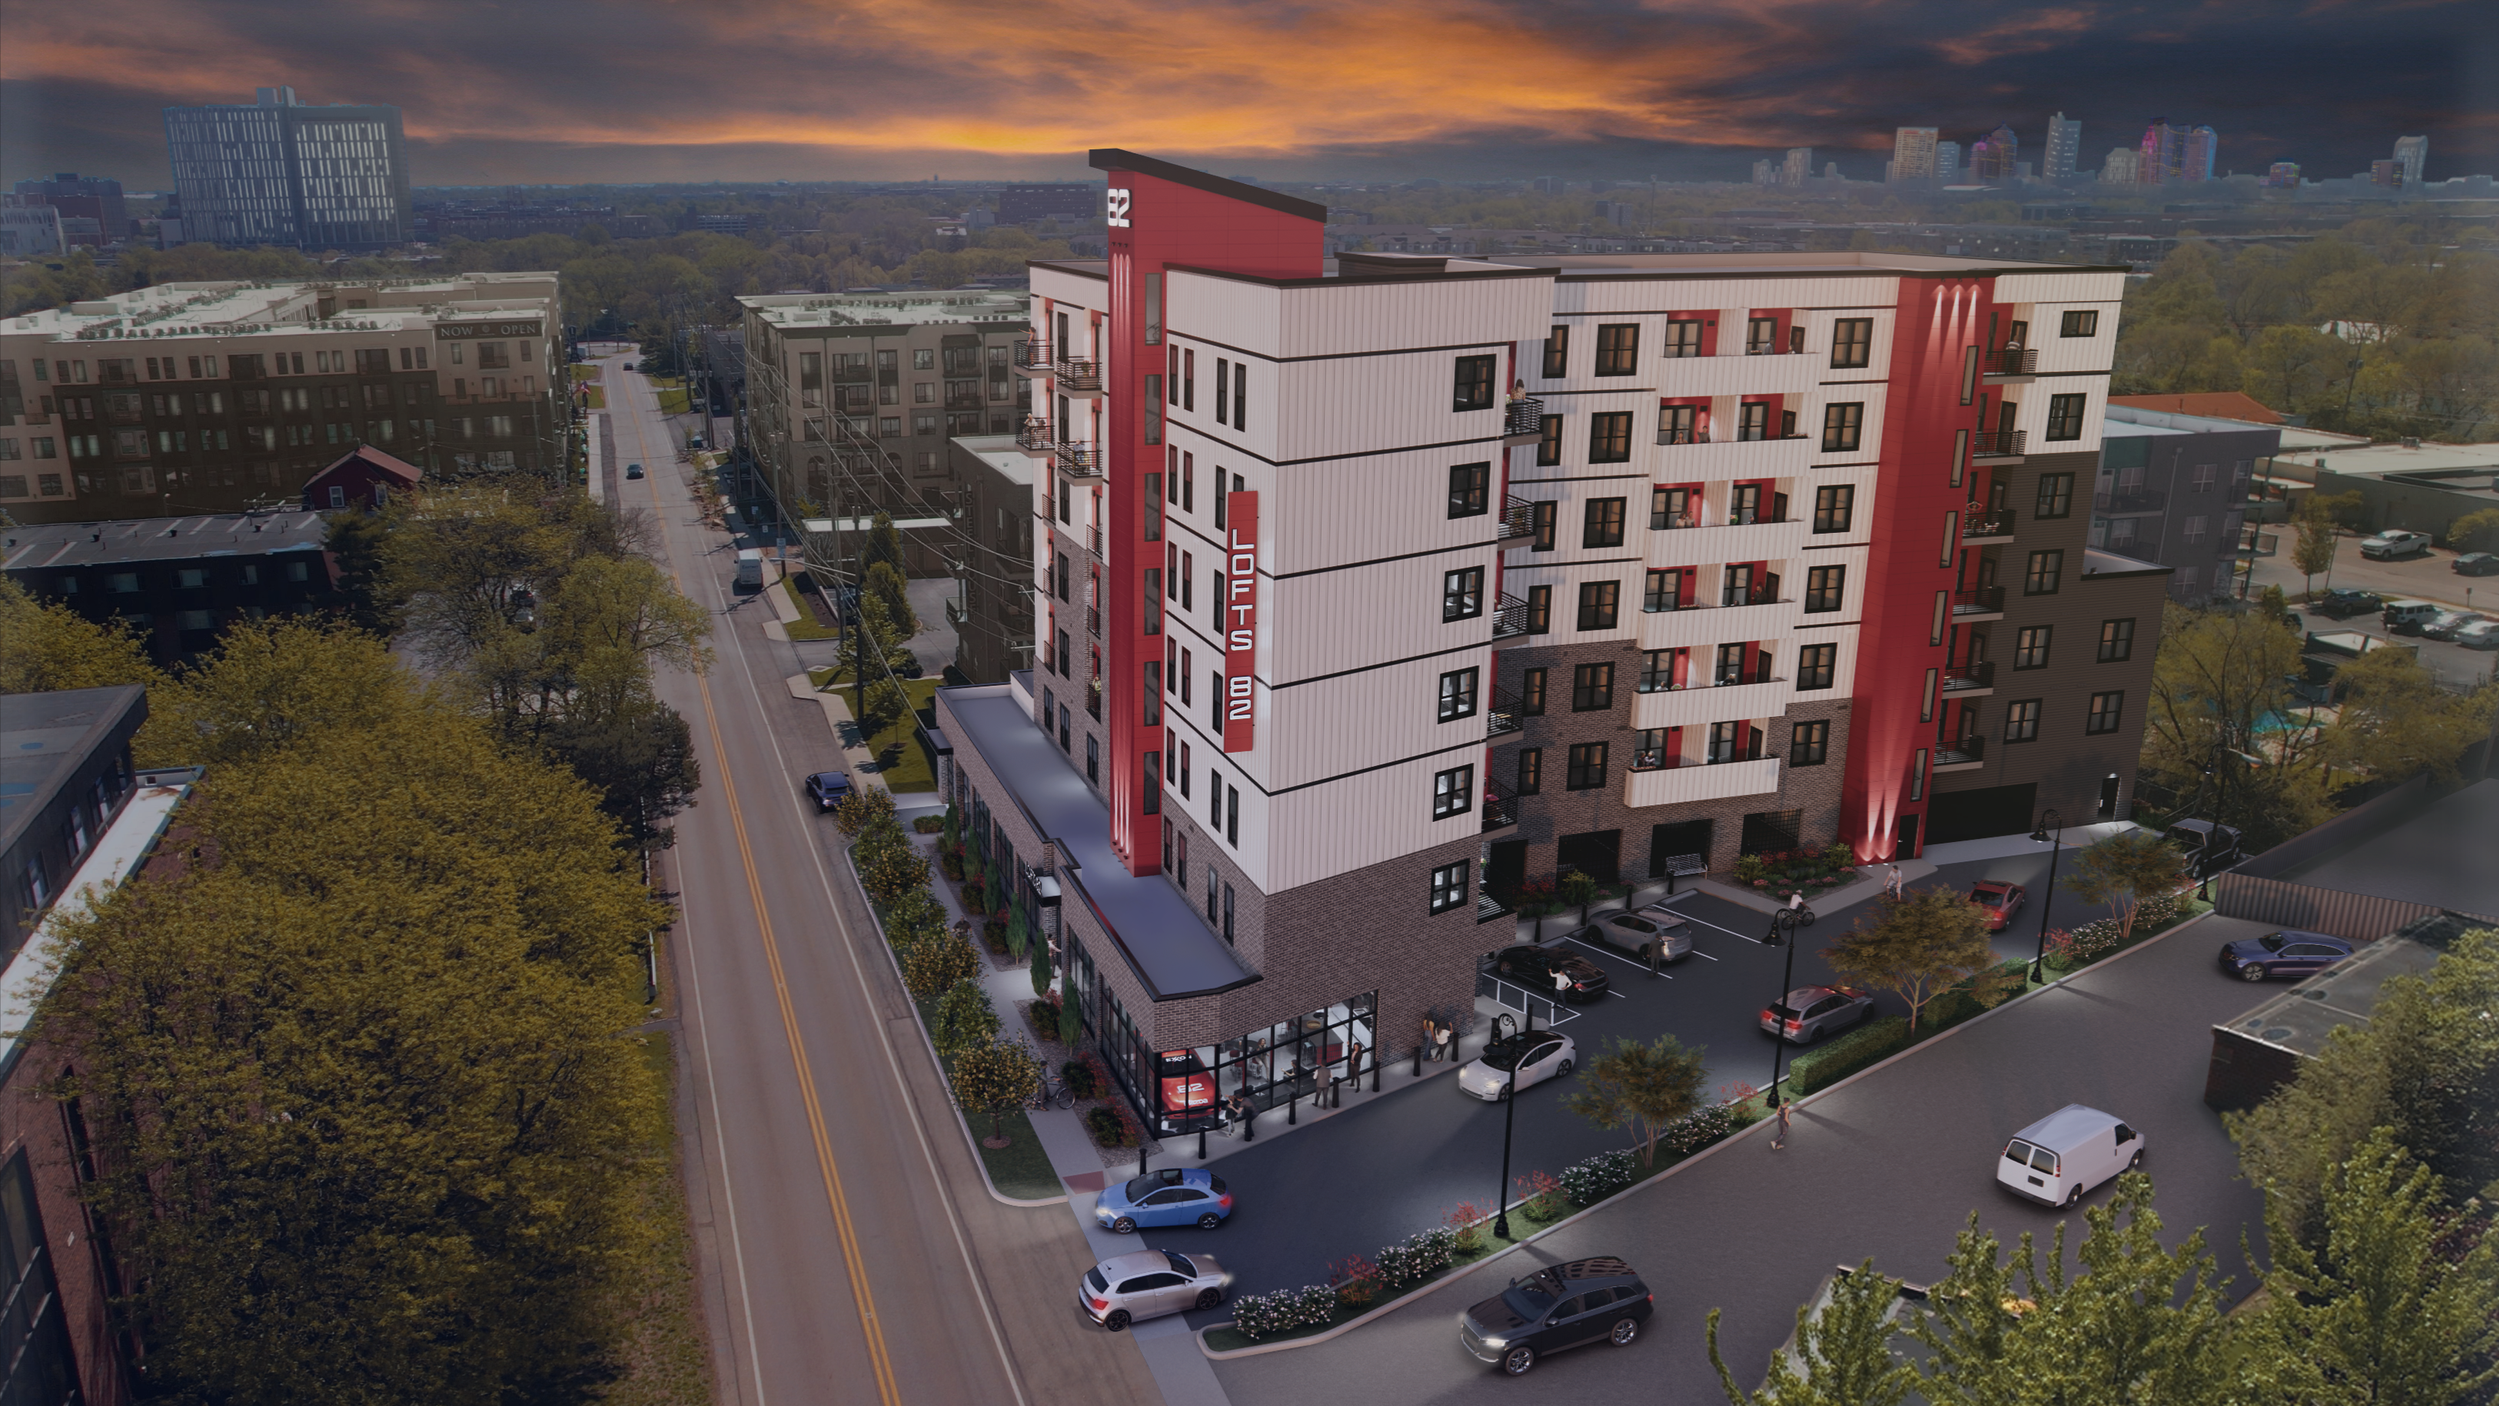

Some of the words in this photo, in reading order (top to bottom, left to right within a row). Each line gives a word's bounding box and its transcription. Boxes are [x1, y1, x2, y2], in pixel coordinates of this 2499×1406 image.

[1107, 188, 1130, 228] 82
[441, 326, 473, 337] NOW
[501, 324, 536, 335] OPEN
[1230, 528, 1255, 651] LOFTS
[1229, 676, 1252, 721] 82
